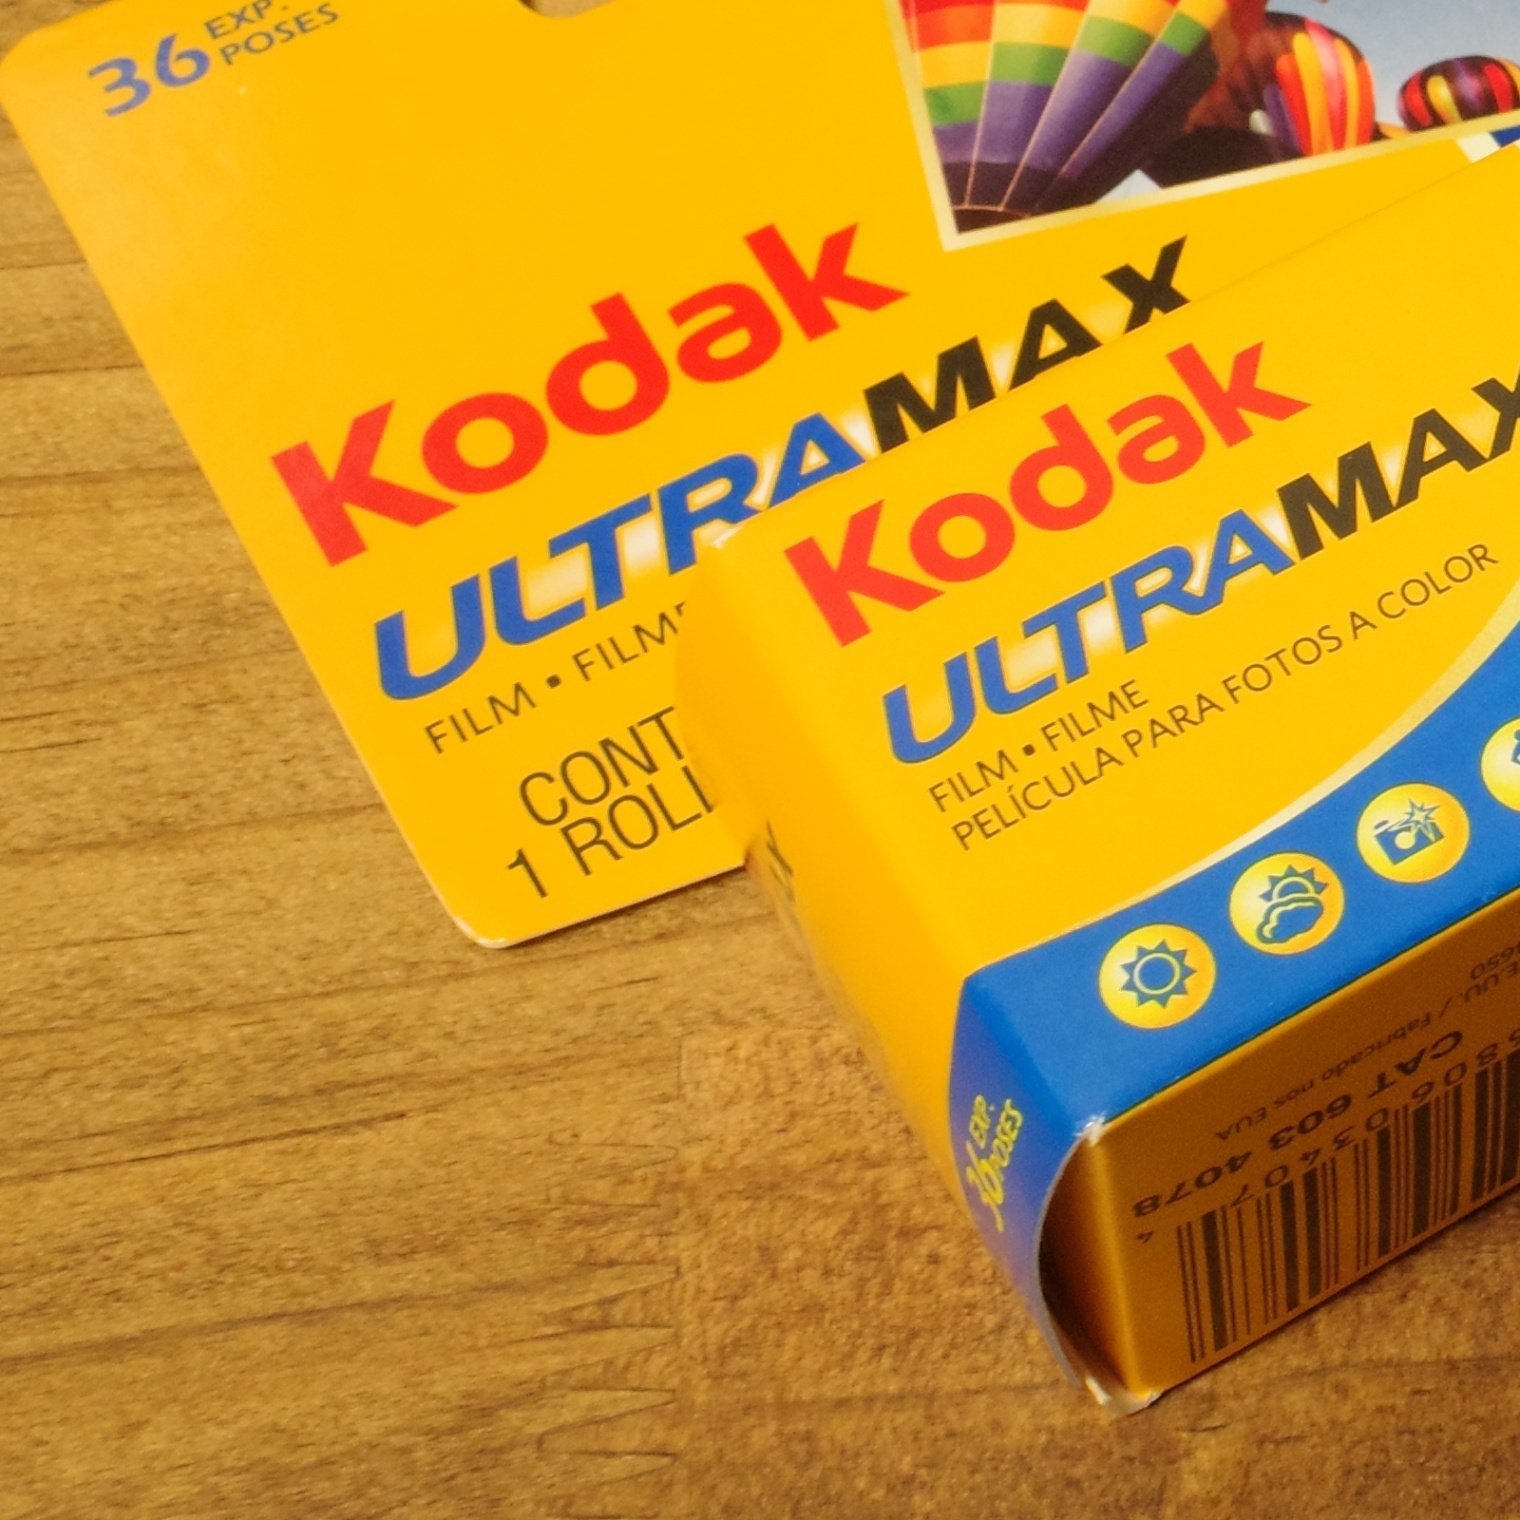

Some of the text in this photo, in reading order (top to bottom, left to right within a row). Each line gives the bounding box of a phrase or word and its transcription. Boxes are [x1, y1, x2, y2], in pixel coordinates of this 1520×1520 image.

[87, 32, 211, 118] 36
[218, 2, 341, 67] POSES
[269, 221, 911, 569] Kodak
[374, 234, 1190, 702] ULTRAMAX
[783, 340, 1314, 648] Kodak
[424, 681, 538, 756] FILM
[950, 541, 1500, 851] PELÍCULA PARA FOTOS A COLOR
[927, 678, 1150, 814] FILM FILME
[506, 847, 548, 899] 1
[1321, 1009, 1431, 1085] Fabricado
[1131, 1028, 1464, 1218] CAT 603 4078
[1214, 1104, 1267, 1146] EUA
[1273, 1077, 1314, 1111] nos
